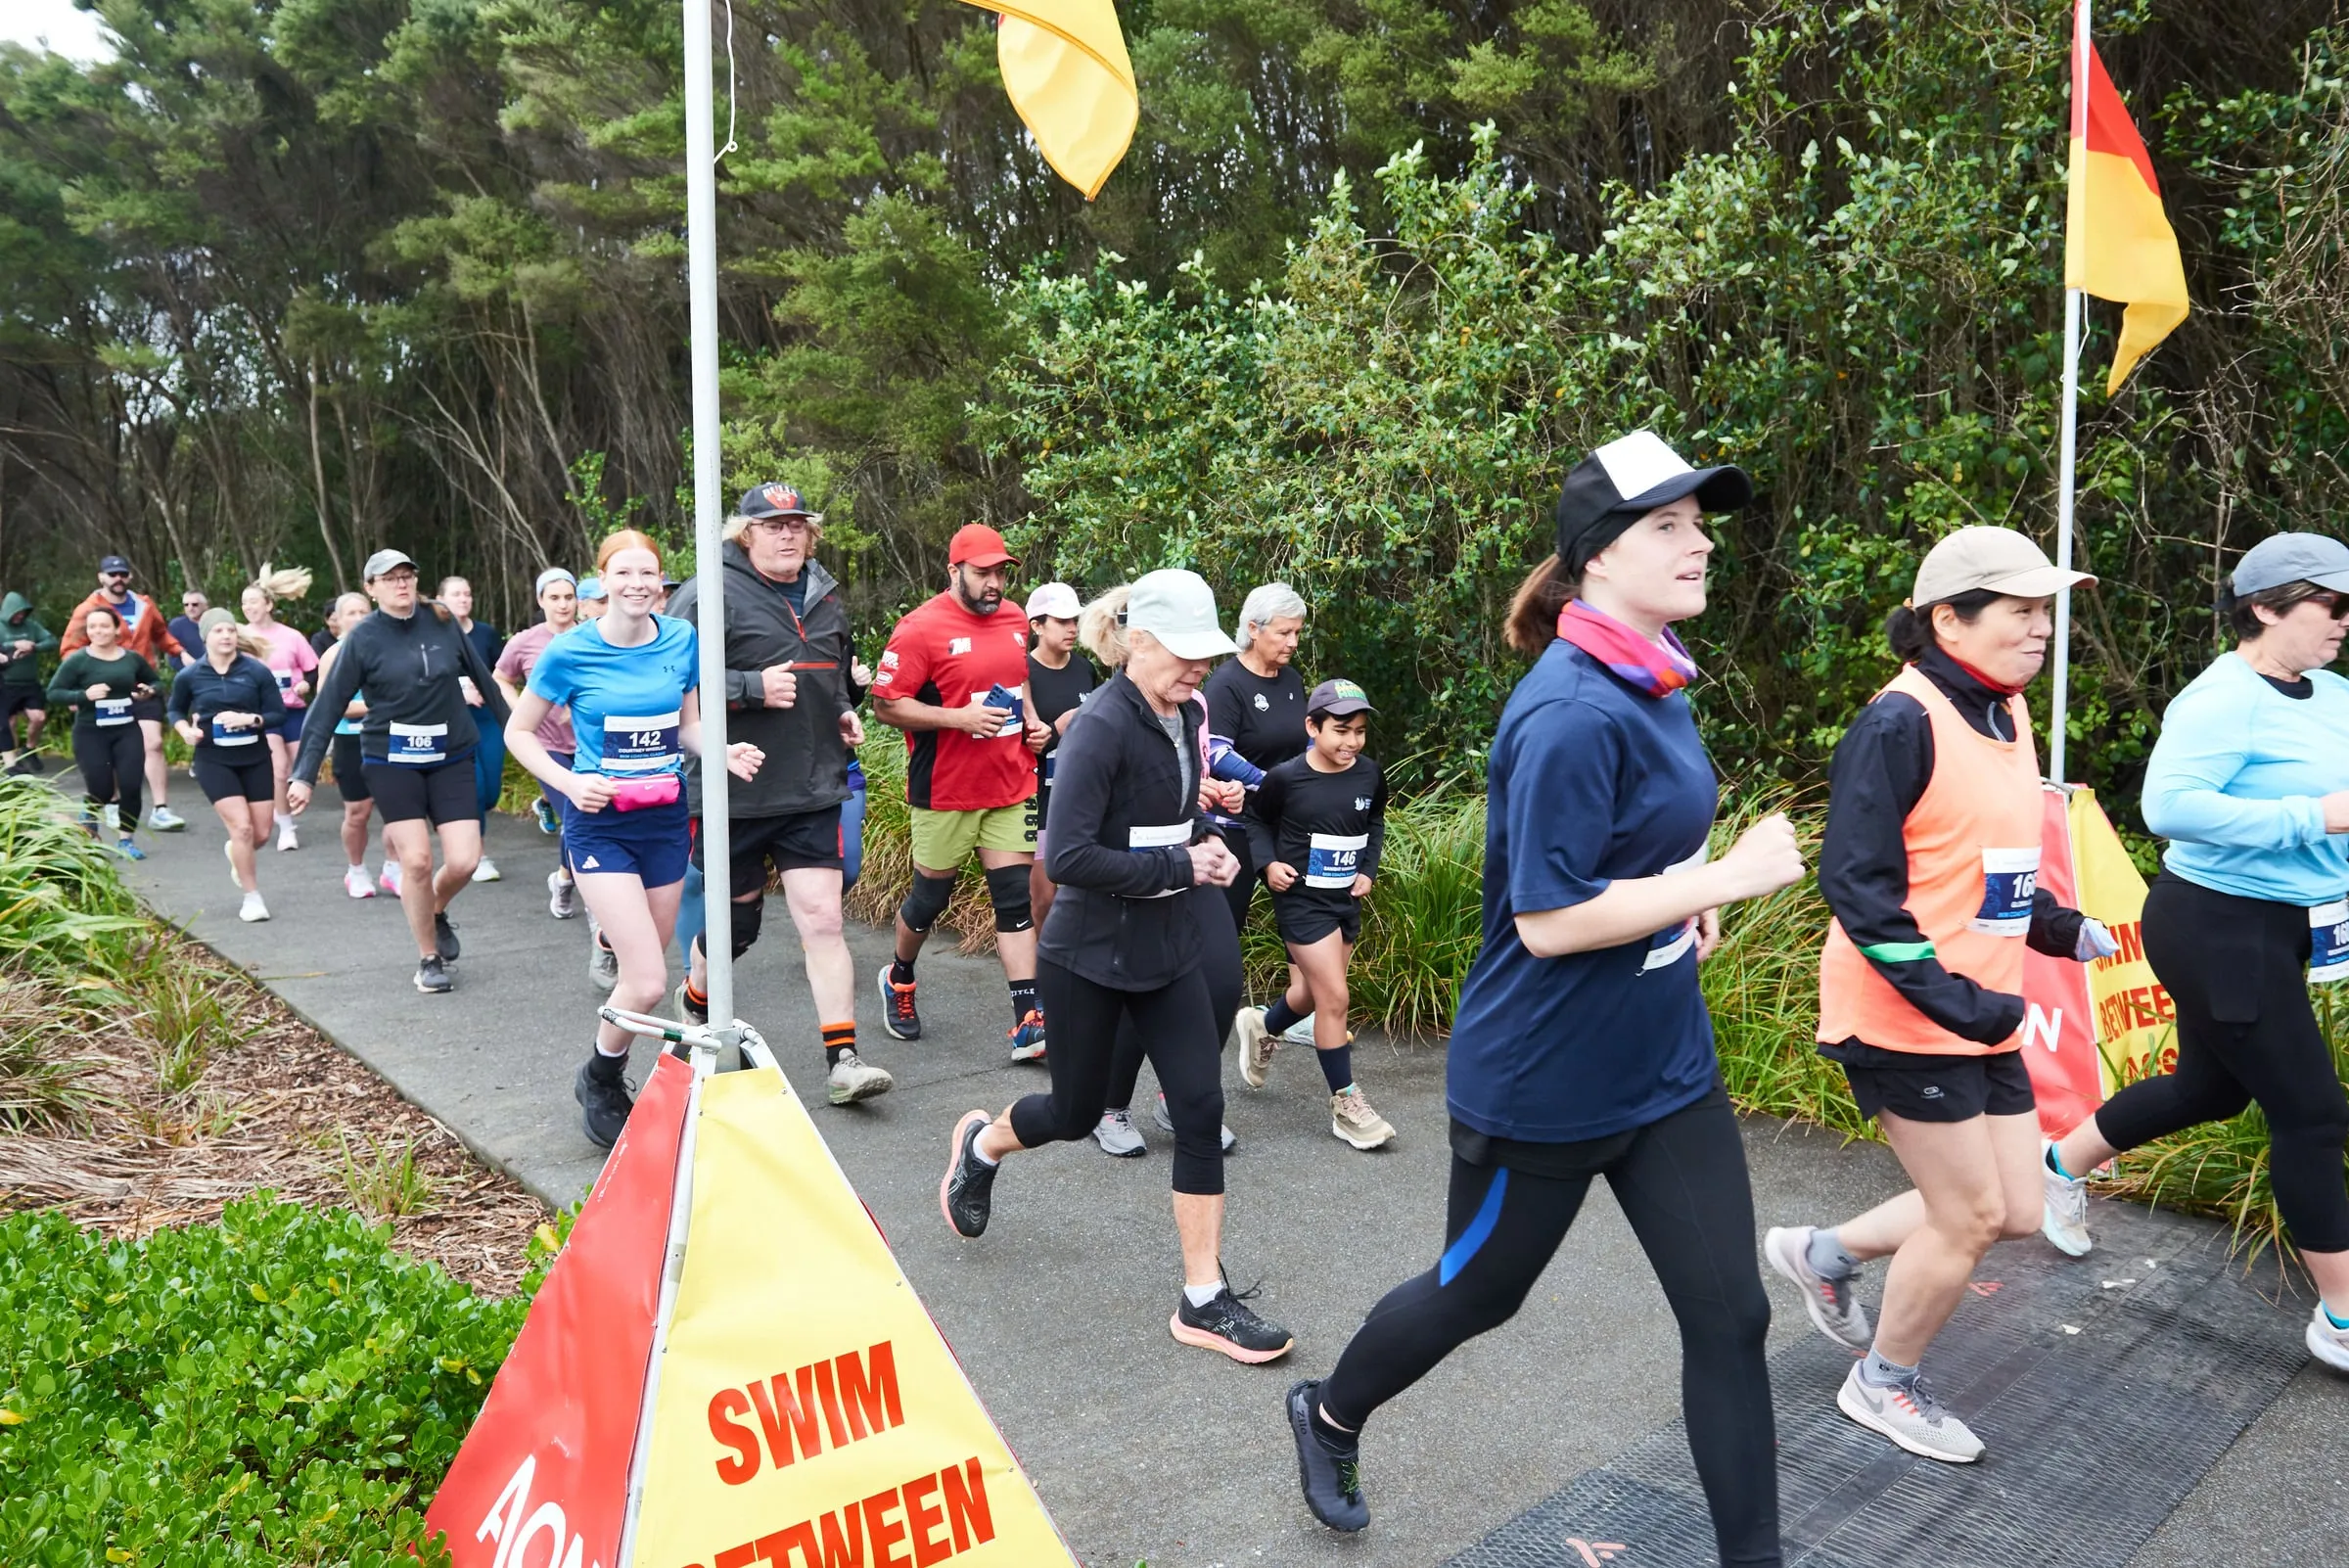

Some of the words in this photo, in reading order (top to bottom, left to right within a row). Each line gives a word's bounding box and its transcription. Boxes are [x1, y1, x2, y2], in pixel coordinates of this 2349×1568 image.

[407, 736, 433, 748] 106
[629, 731, 662, 747] 142
[1332, 852, 1357, 866] 146
[2099, 984, 2176, 1043] BETWEE
[708, 1340, 904, 1486] SWIM
